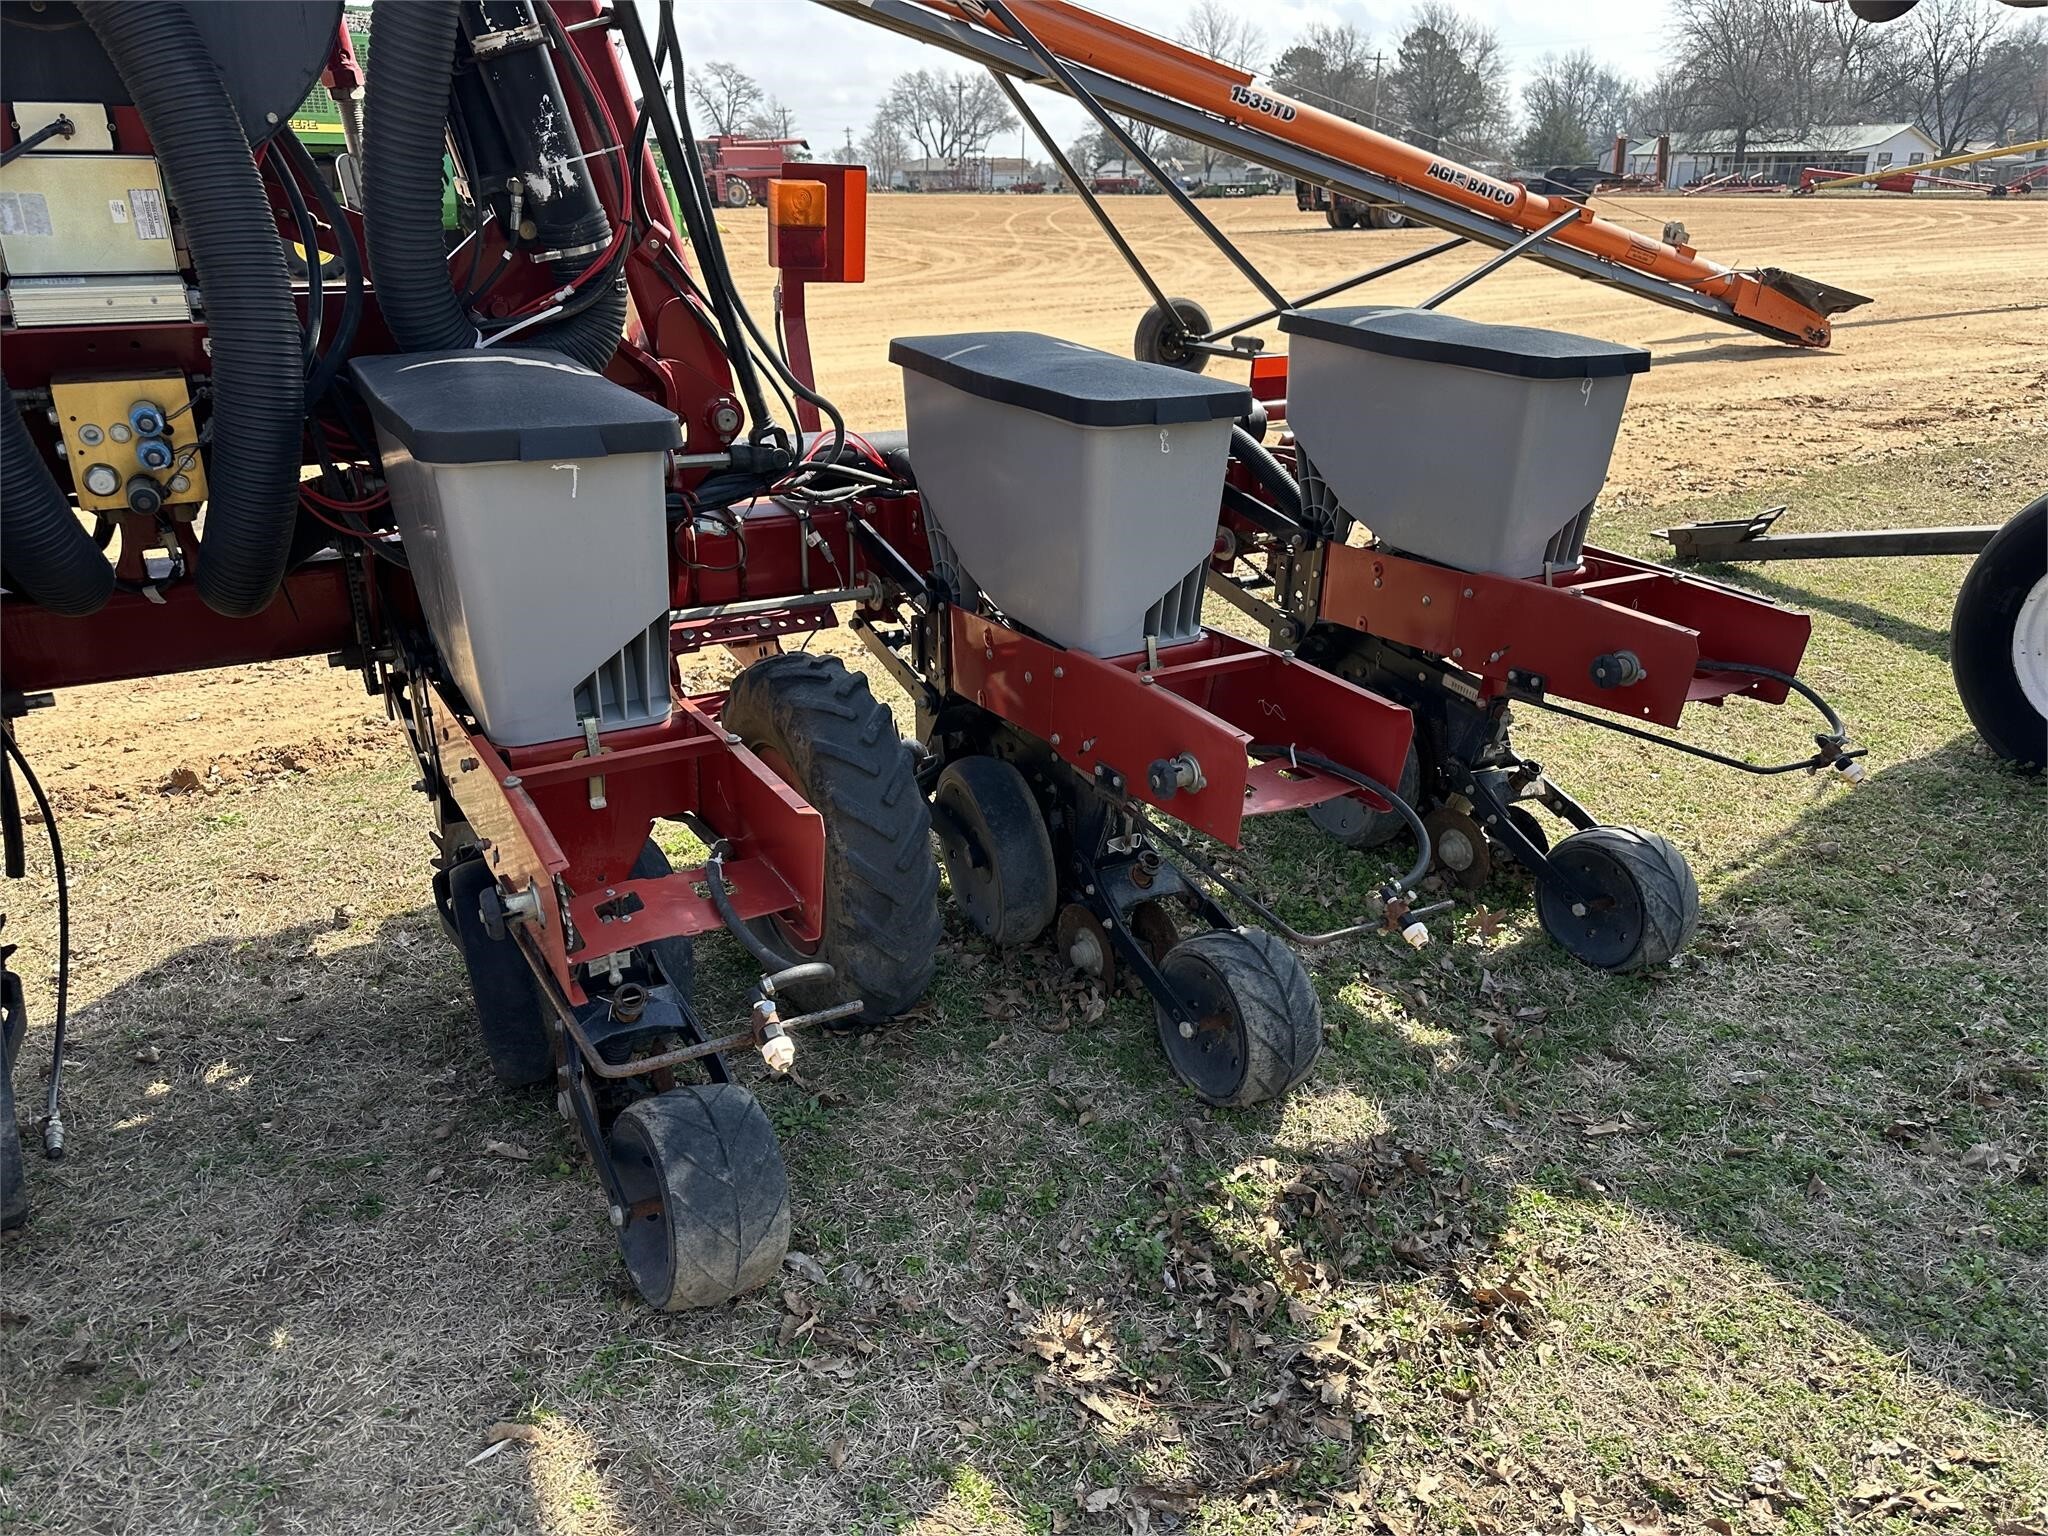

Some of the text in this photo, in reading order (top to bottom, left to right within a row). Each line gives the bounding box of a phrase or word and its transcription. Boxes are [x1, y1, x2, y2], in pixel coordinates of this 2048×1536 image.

[1231, 85, 1296, 121] 1535TD
[1427, 162, 1515, 206] AGI BATCO
[1581, 377, 1593, 406] 9
[551, 464, 580, 498] 7
